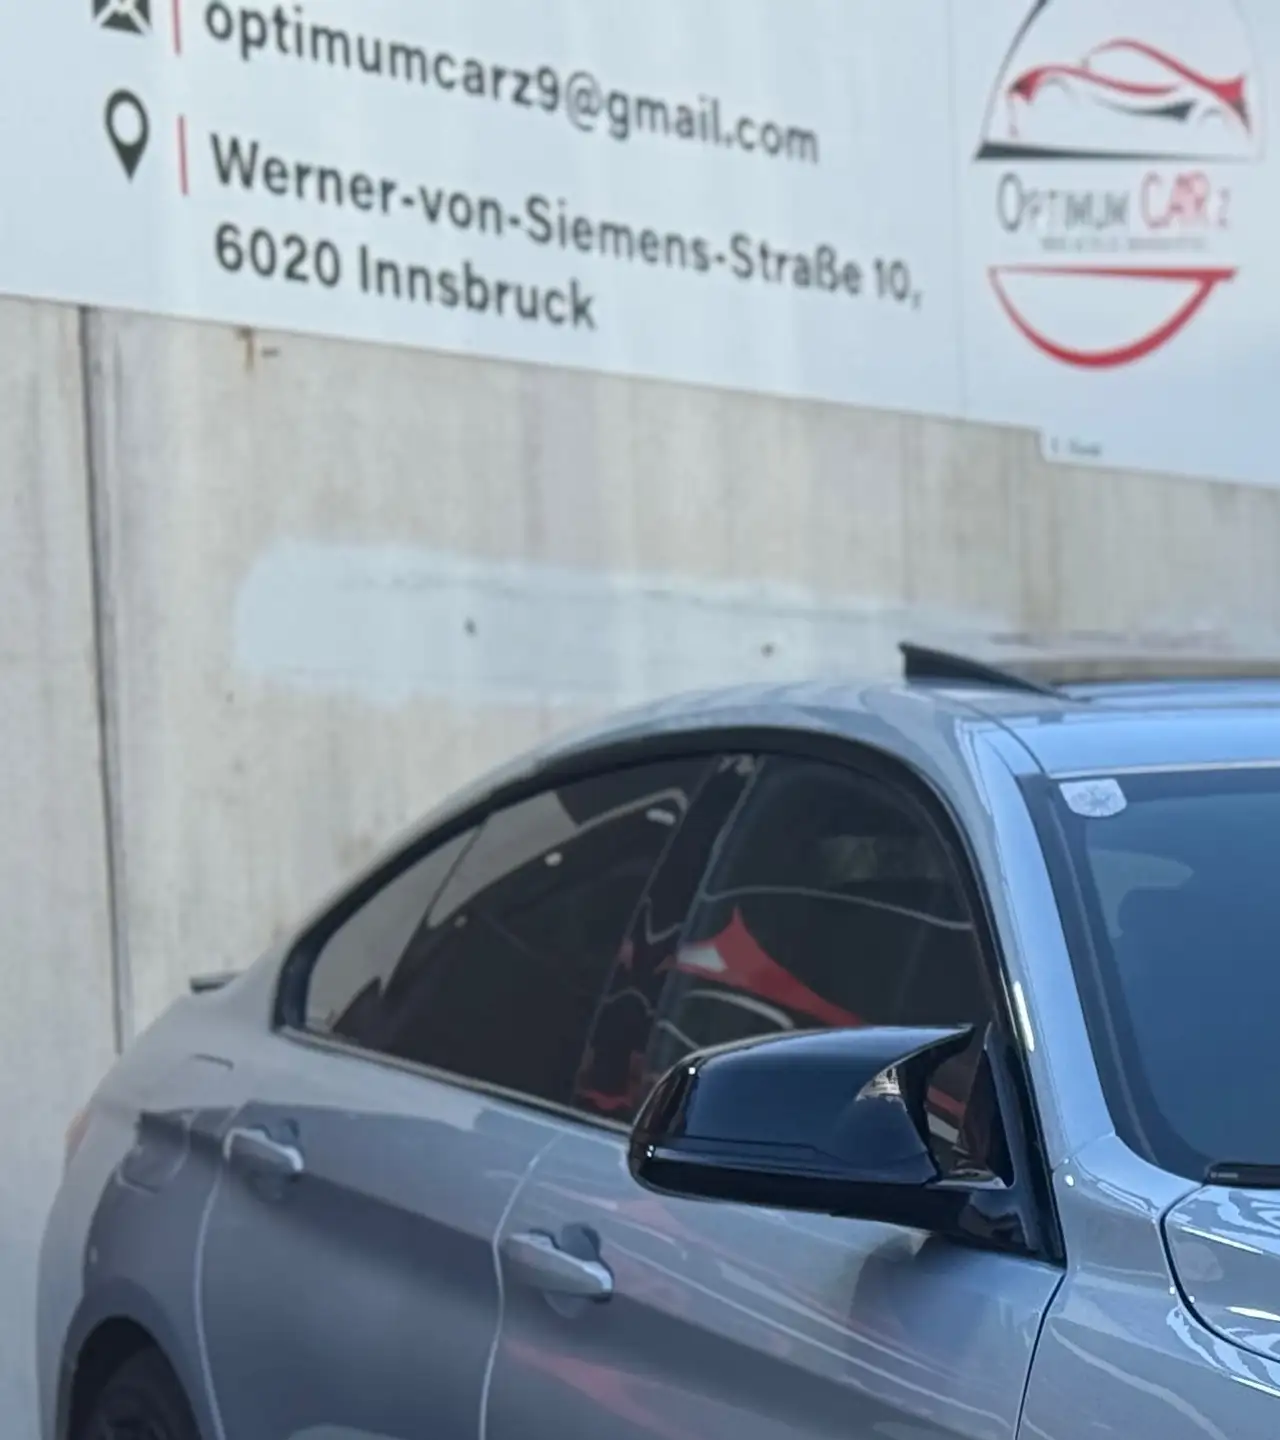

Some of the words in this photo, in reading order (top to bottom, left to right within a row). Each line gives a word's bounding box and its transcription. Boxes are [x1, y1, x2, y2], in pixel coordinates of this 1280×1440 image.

[204, 0, 819, 162] optimumcarz9@gmail.com
[210, 132, 862, 296] Werner-von-Siemens-Straße
[874, 257, 922, 310] 10,
[214, 222, 341, 288] 6020
[359, 244, 597, 330] Innsbruck
